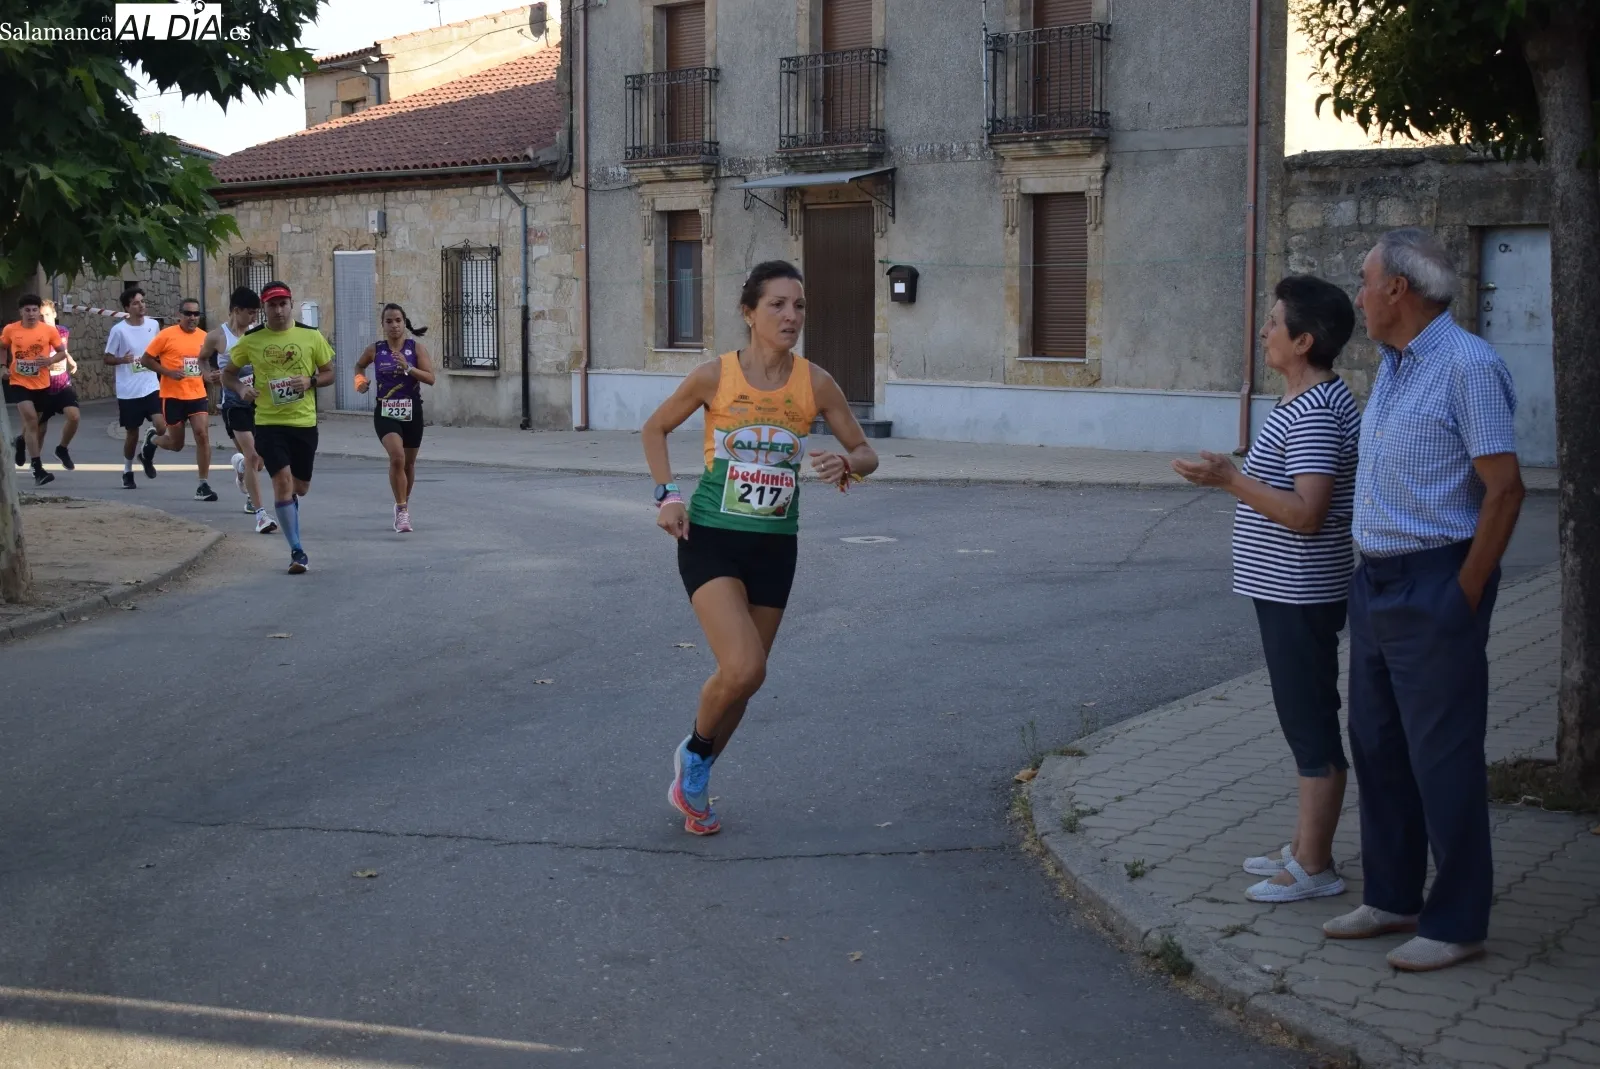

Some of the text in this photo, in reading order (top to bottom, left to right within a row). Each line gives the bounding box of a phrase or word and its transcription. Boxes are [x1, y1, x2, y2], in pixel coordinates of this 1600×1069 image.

[20, 365, 35, 373] 221
[388, 408, 406, 416] 232
[732, 440, 794, 454] ALCER
[728, 465, 794, 487] bedunia
[737, 483, 782, 507] 217
